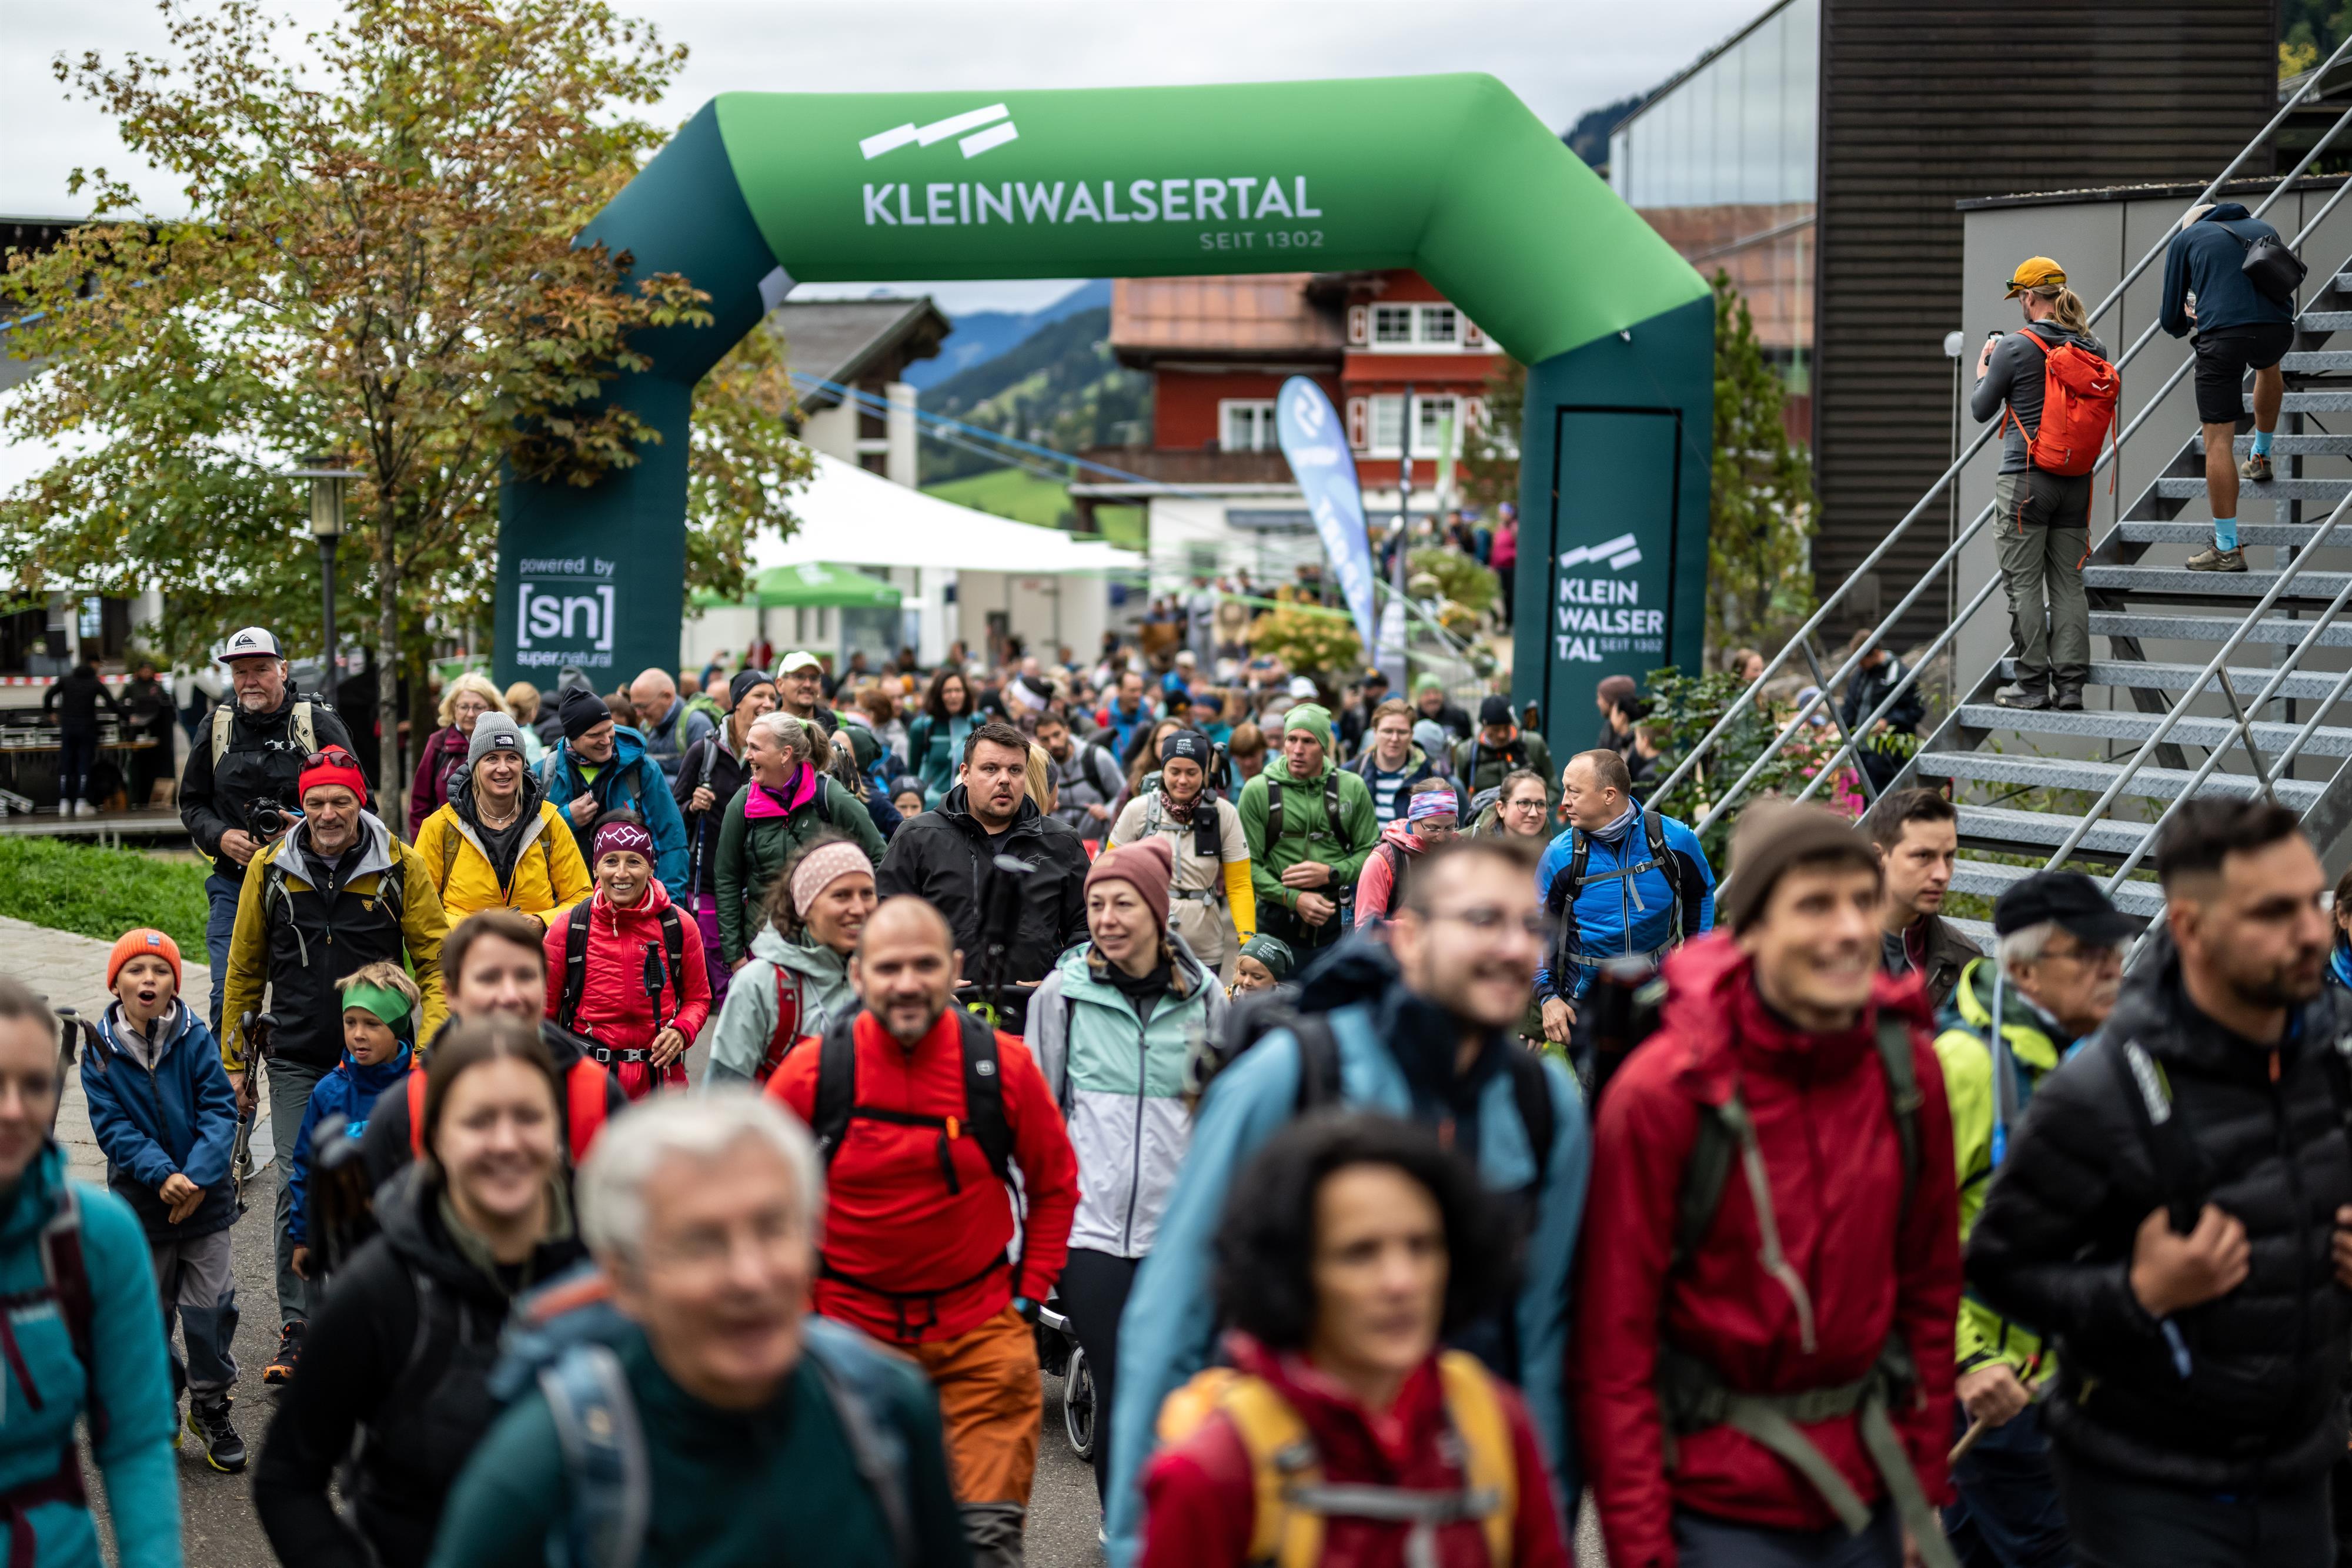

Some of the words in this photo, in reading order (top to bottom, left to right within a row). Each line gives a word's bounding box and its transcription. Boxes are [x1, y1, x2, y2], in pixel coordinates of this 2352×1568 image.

[863, 175, 1323, 225] KLEINWALSERTAL
[1198, 232, 1256, 250] SEIT
[1265, 230, 1325, 248] 1302
[520, 557, 586, 574] powered
[593, 558, 615, 578] by
[1560, 577, 1639, 605] KLEIN
[517, 583, 615, 651] [sn]
[1558, 606, 1665, 635] WALSER
[516, 650, 612, 668] super.natural
[1556, 635, 1603, 663] TAL
[1600, 637, 1630, 652] SEIT
[1634, 638, 1663, 653] 1302
[1259, 947, 1275, 961] WALSER
[1262, 944, 1274, 954] KLEIN
